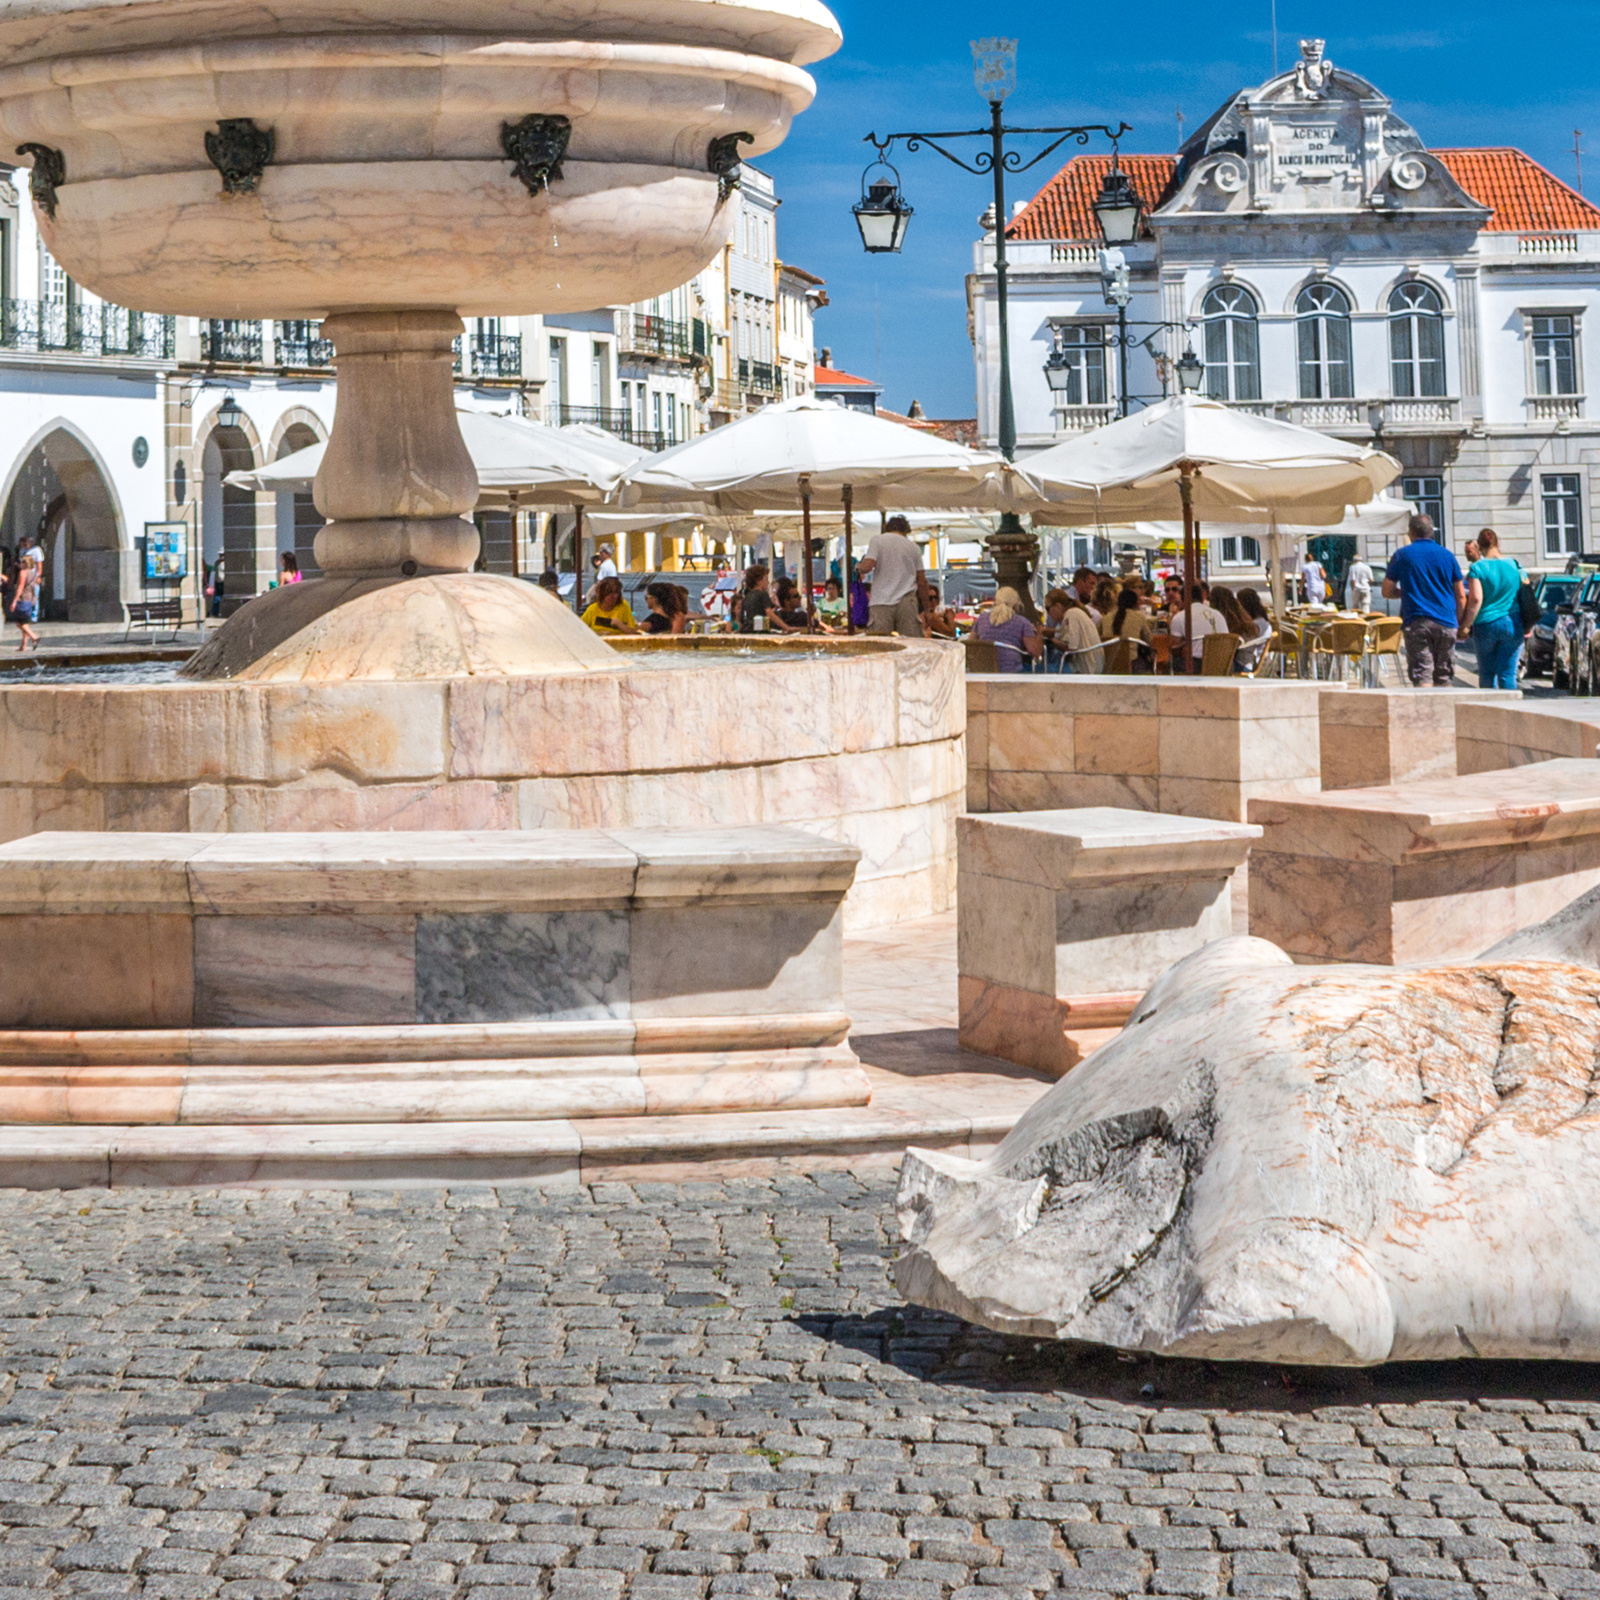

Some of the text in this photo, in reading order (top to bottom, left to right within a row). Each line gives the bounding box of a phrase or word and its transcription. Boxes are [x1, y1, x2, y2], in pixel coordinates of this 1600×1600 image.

[1293, 128, 1338, 139] AGENCIA
[1308, 143, 1324, 151] DO
[1278, 154, 1302, 165] BANCO
[1315, 153, 1354, 165] PORTUGAL
